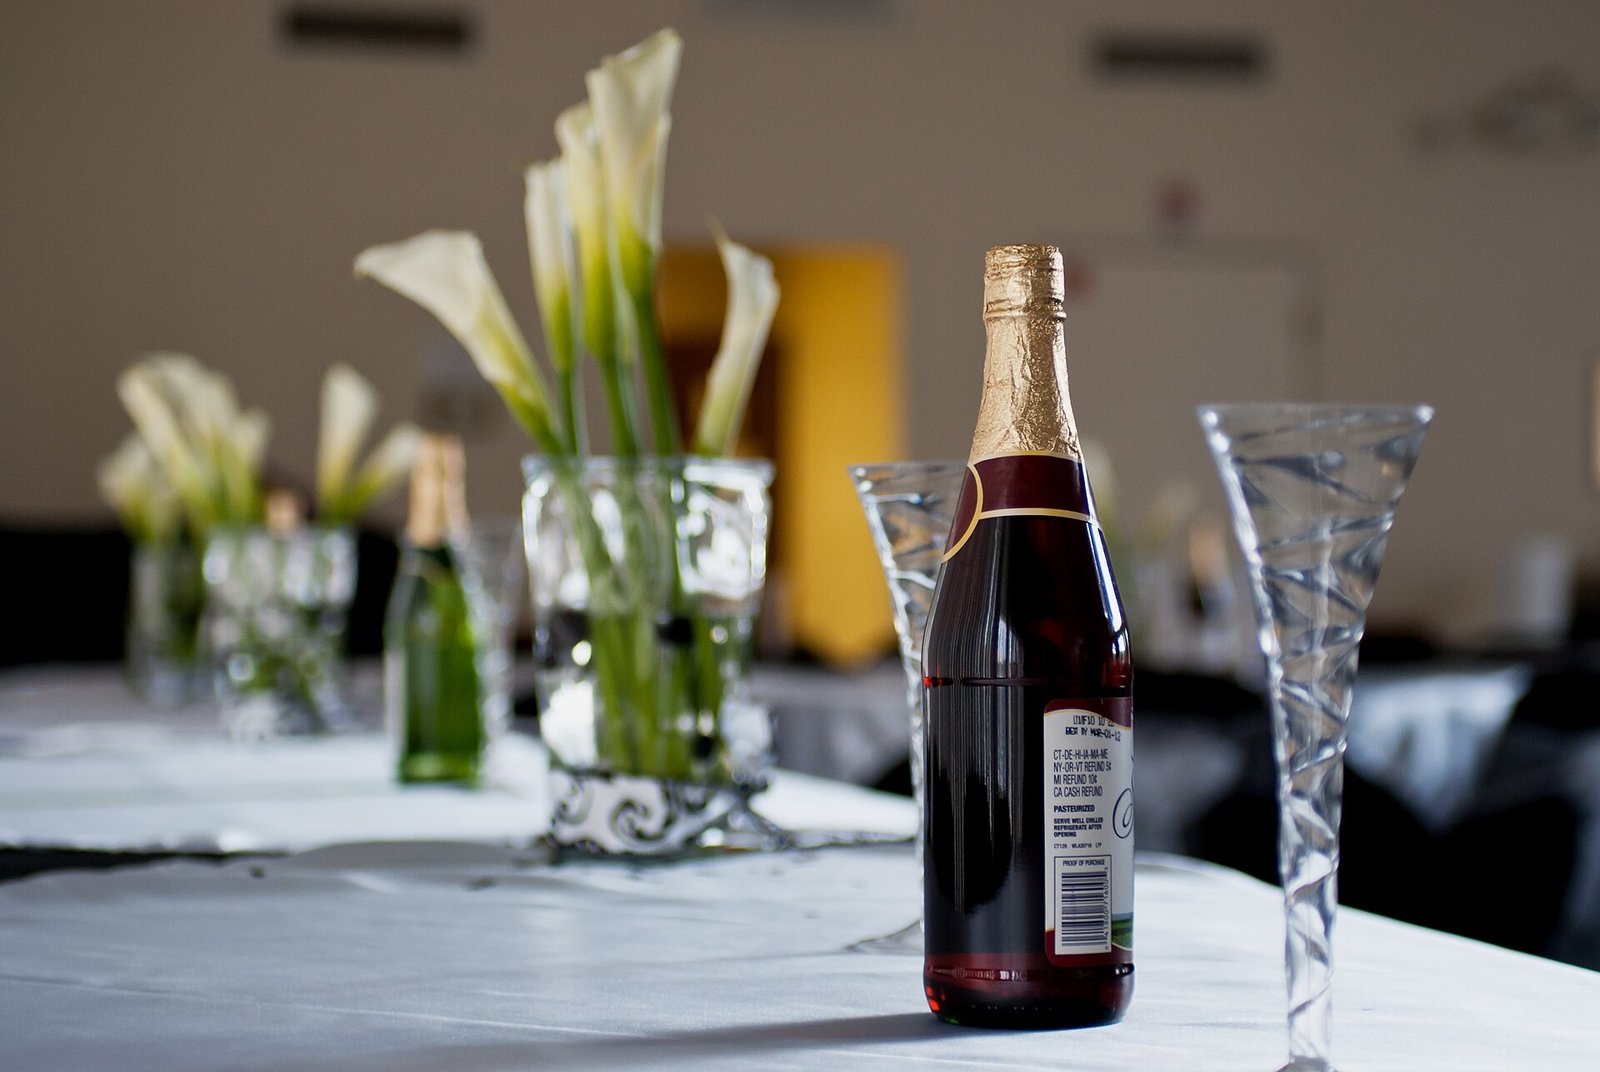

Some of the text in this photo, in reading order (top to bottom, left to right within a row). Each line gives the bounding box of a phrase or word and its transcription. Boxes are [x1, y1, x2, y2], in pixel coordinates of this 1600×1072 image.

[1053, 749, 1108, 760] CT-DE-HI-IA-MA-ME
[1053, 761, 1083, 772] NY-OR-VT
[1084, 761, 1105, 772] REFUND
[1053, 774, 1062, 785] MI
[1063, 774, 1087, 785] REFUND
[1053, 785, 1103, 797] CA CASH REFUND
